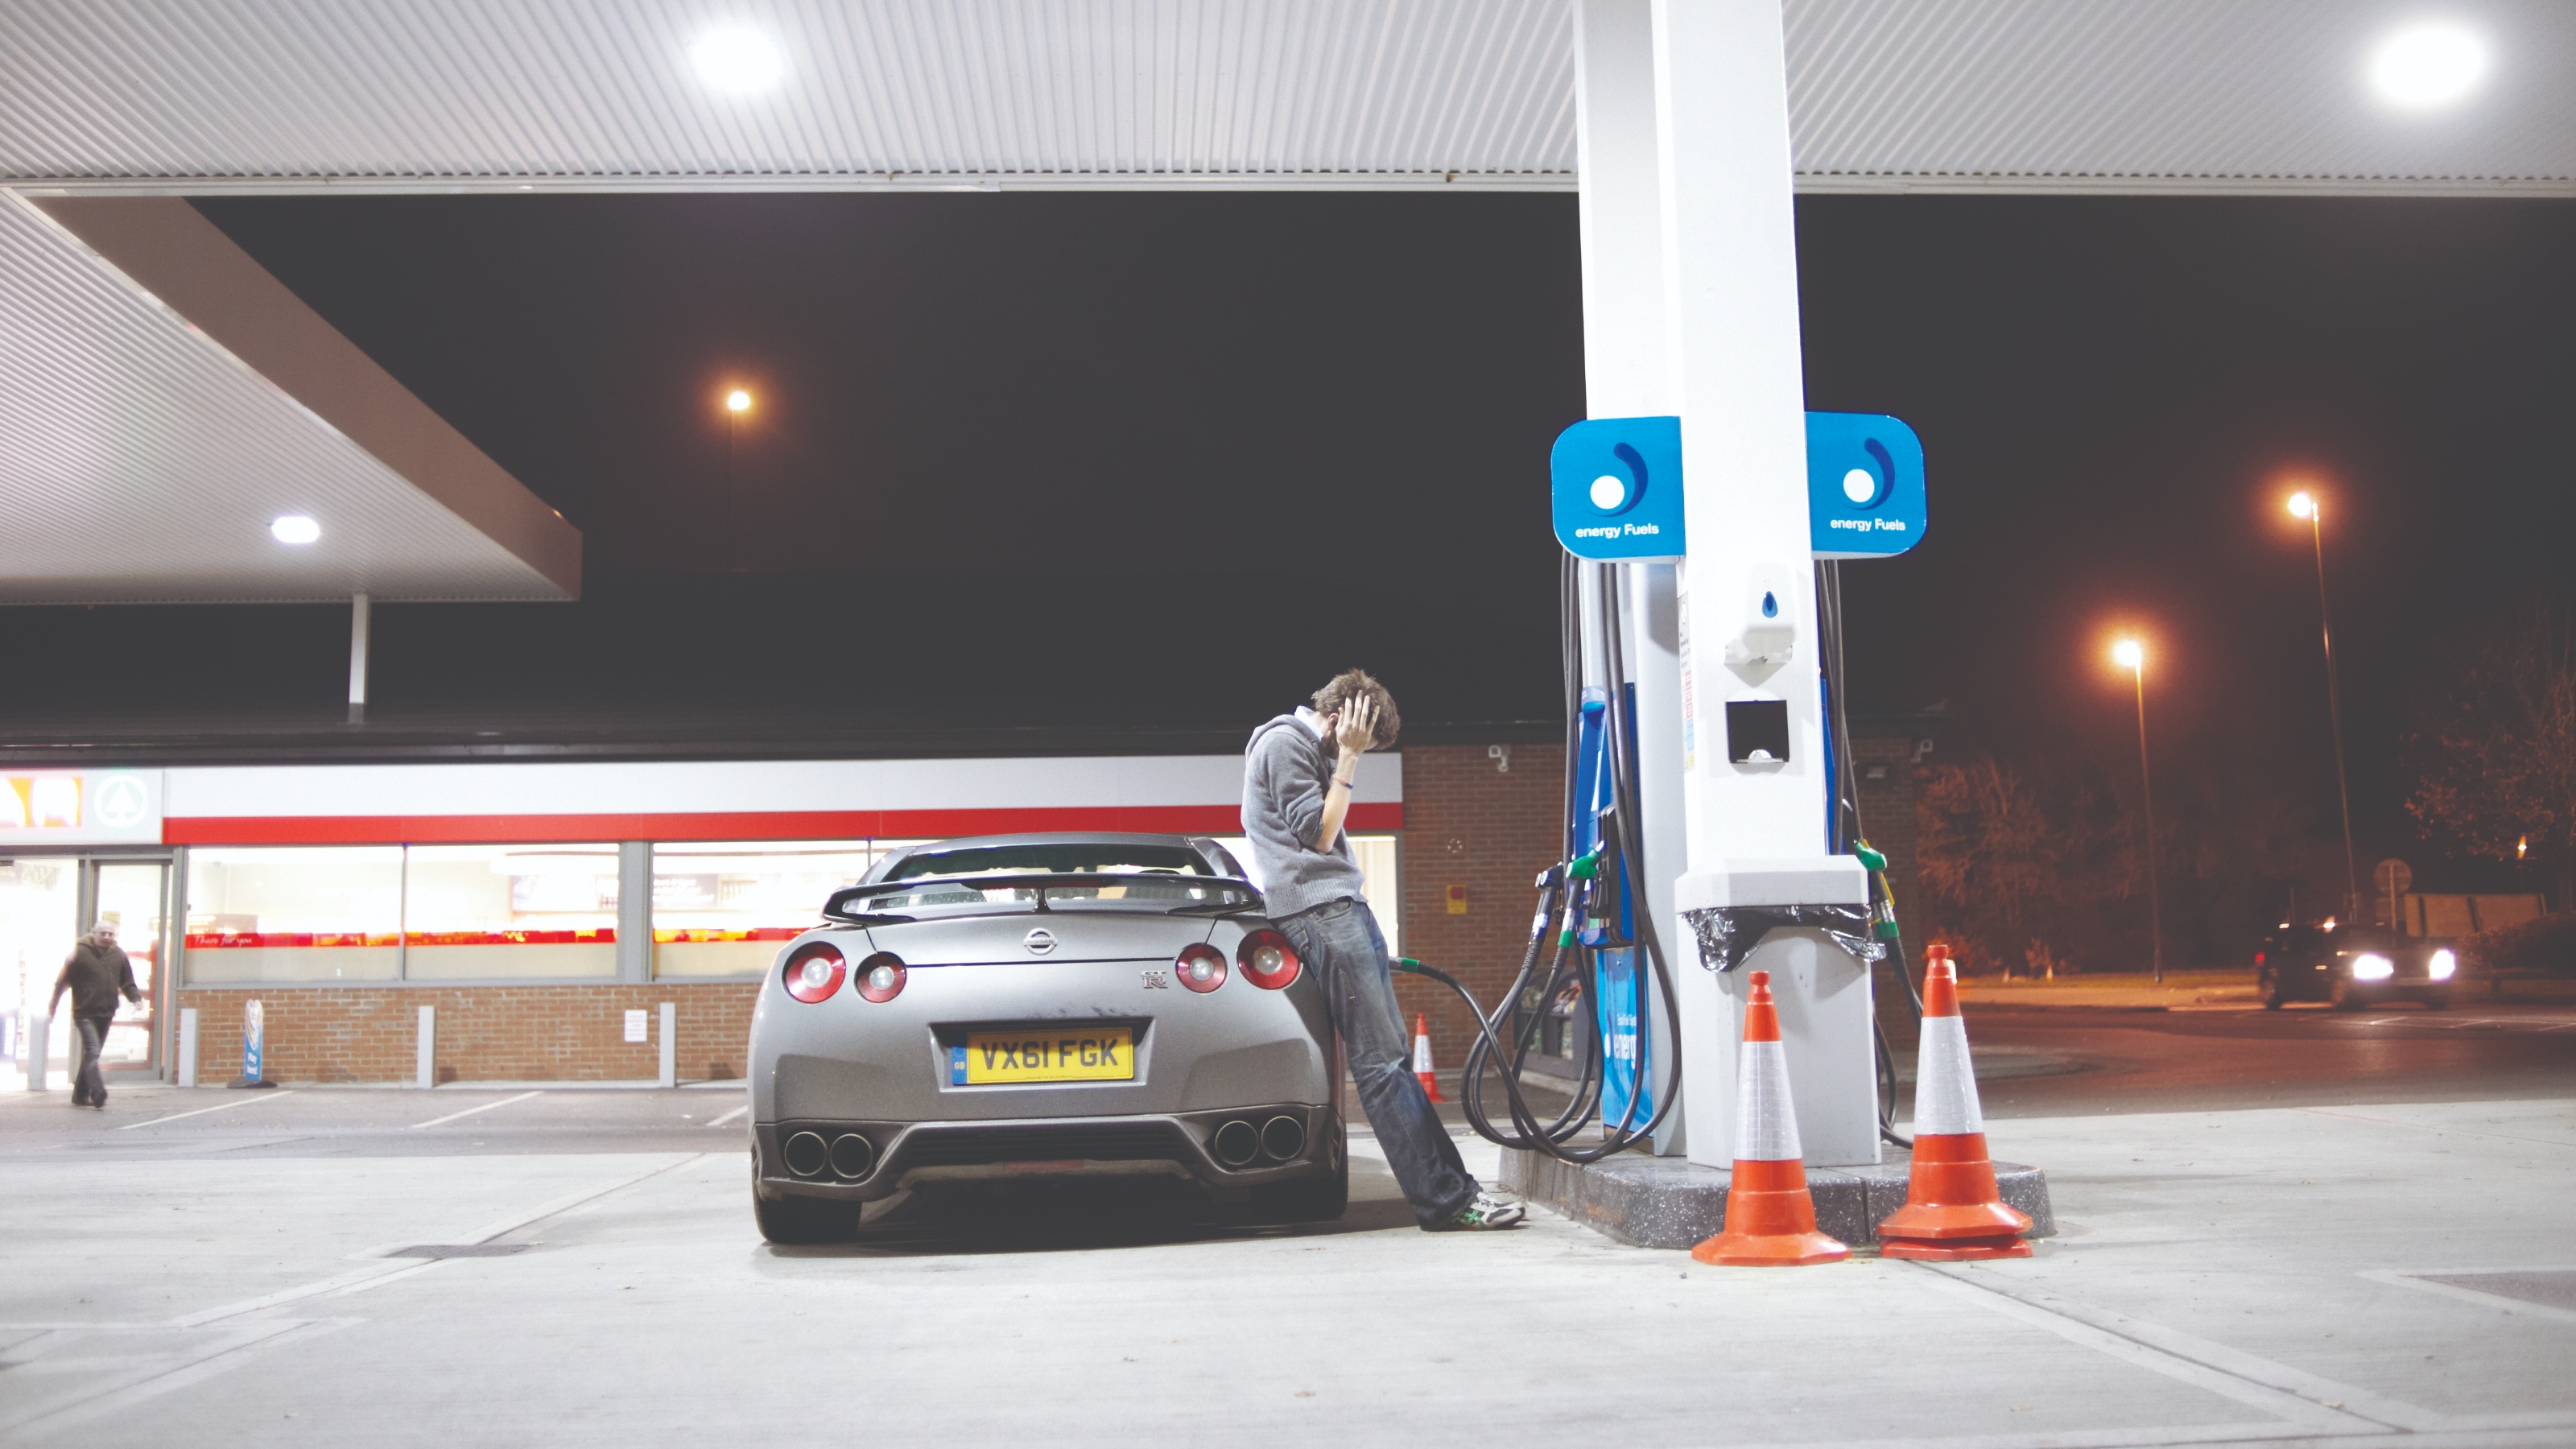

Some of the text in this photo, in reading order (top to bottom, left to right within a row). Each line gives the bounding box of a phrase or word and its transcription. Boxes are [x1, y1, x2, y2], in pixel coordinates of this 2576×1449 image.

[1575, 522, 1660, 539] energy Fuels
[1830, 518, 1906, 532] energy Fuels
[981, 1038, 1119, 1071] VX61 FGK
